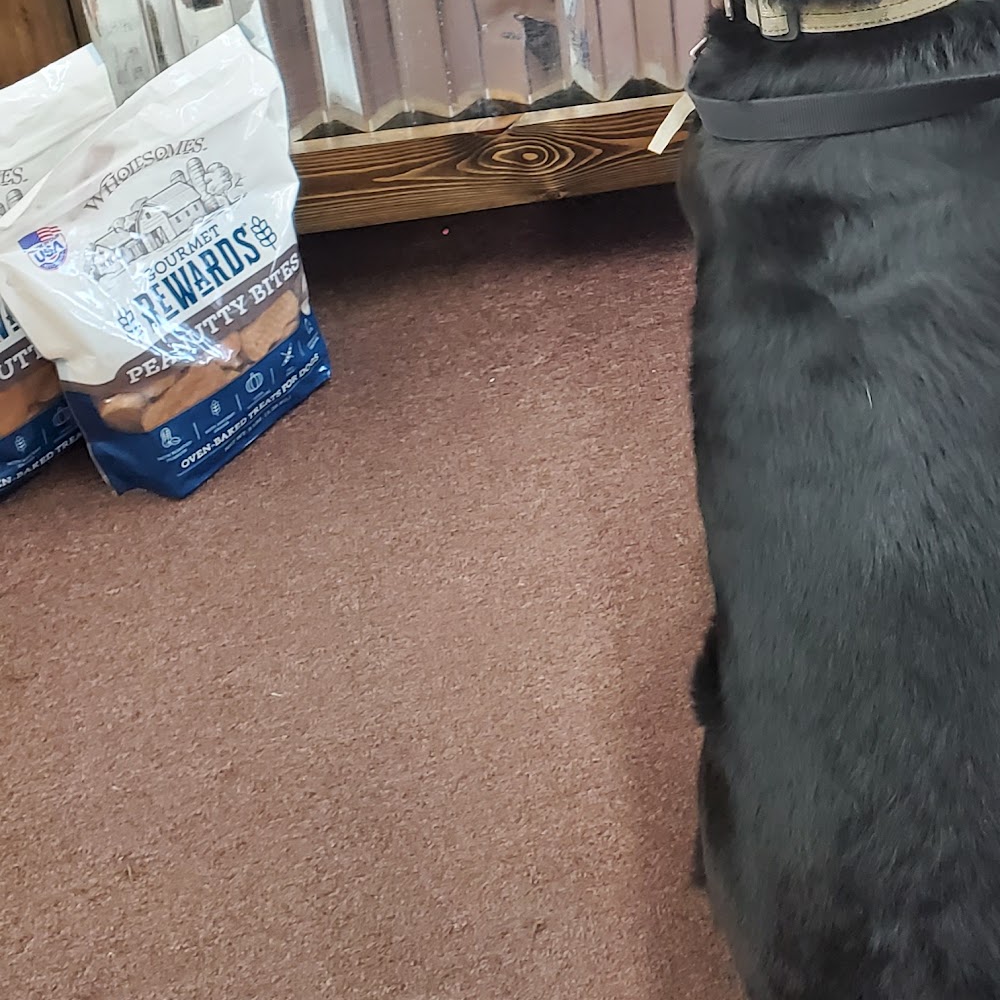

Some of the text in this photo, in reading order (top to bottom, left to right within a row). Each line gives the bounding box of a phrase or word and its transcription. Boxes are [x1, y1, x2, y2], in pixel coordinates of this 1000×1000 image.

[34, 241, 64, 263] USA
[133, 226, 262, 327] REWARDS
[144, 224, 221, 282] GOURMET
[248, 252, 299, 305] BITES
[181, 417, 248, 469] OVEN-BAKED
[248, 388, 282, 420] TREATS
[281, 375, 298, 394] FOR
[299, 353, 320, 378] DOGS
[54, 431, 83, 454] TREA
